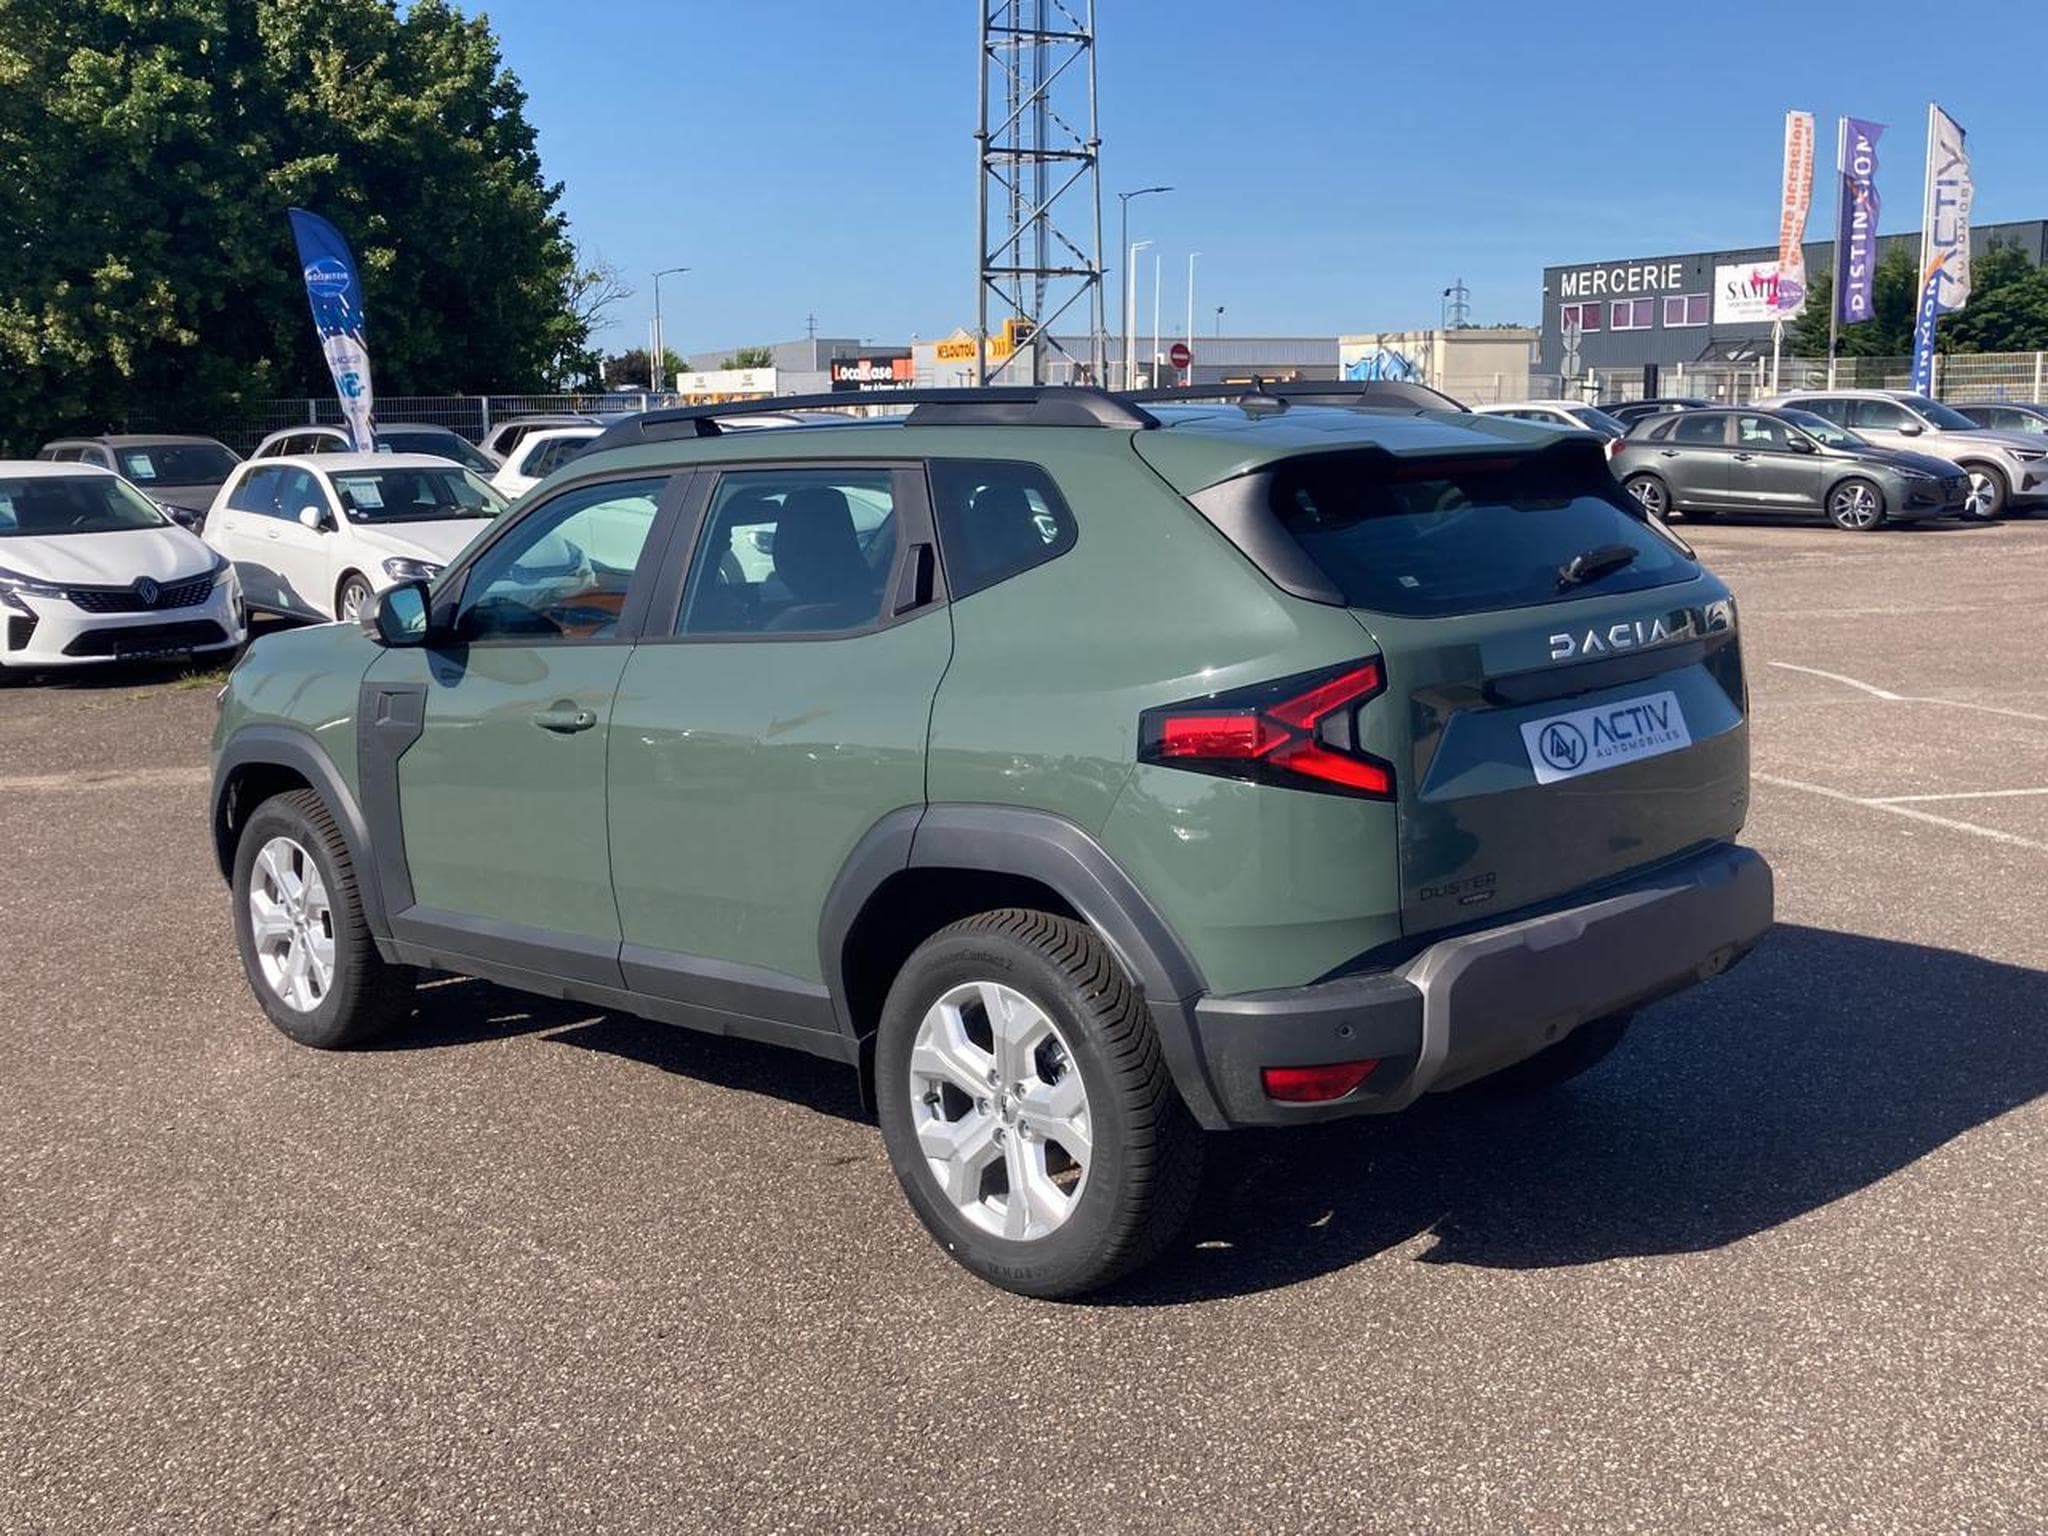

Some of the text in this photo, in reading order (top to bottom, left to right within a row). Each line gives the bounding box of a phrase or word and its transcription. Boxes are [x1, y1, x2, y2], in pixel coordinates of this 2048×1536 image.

[1560, 263, 1683, 298] MERCERIE
[1550, 618, 1669, 660] DACIA
[1592, 700, 1669, 747] ACTIV
[1597, 730, 1681, 758] AUTOMOBILES
[1420, 871, 1497, 902] DUSTER
